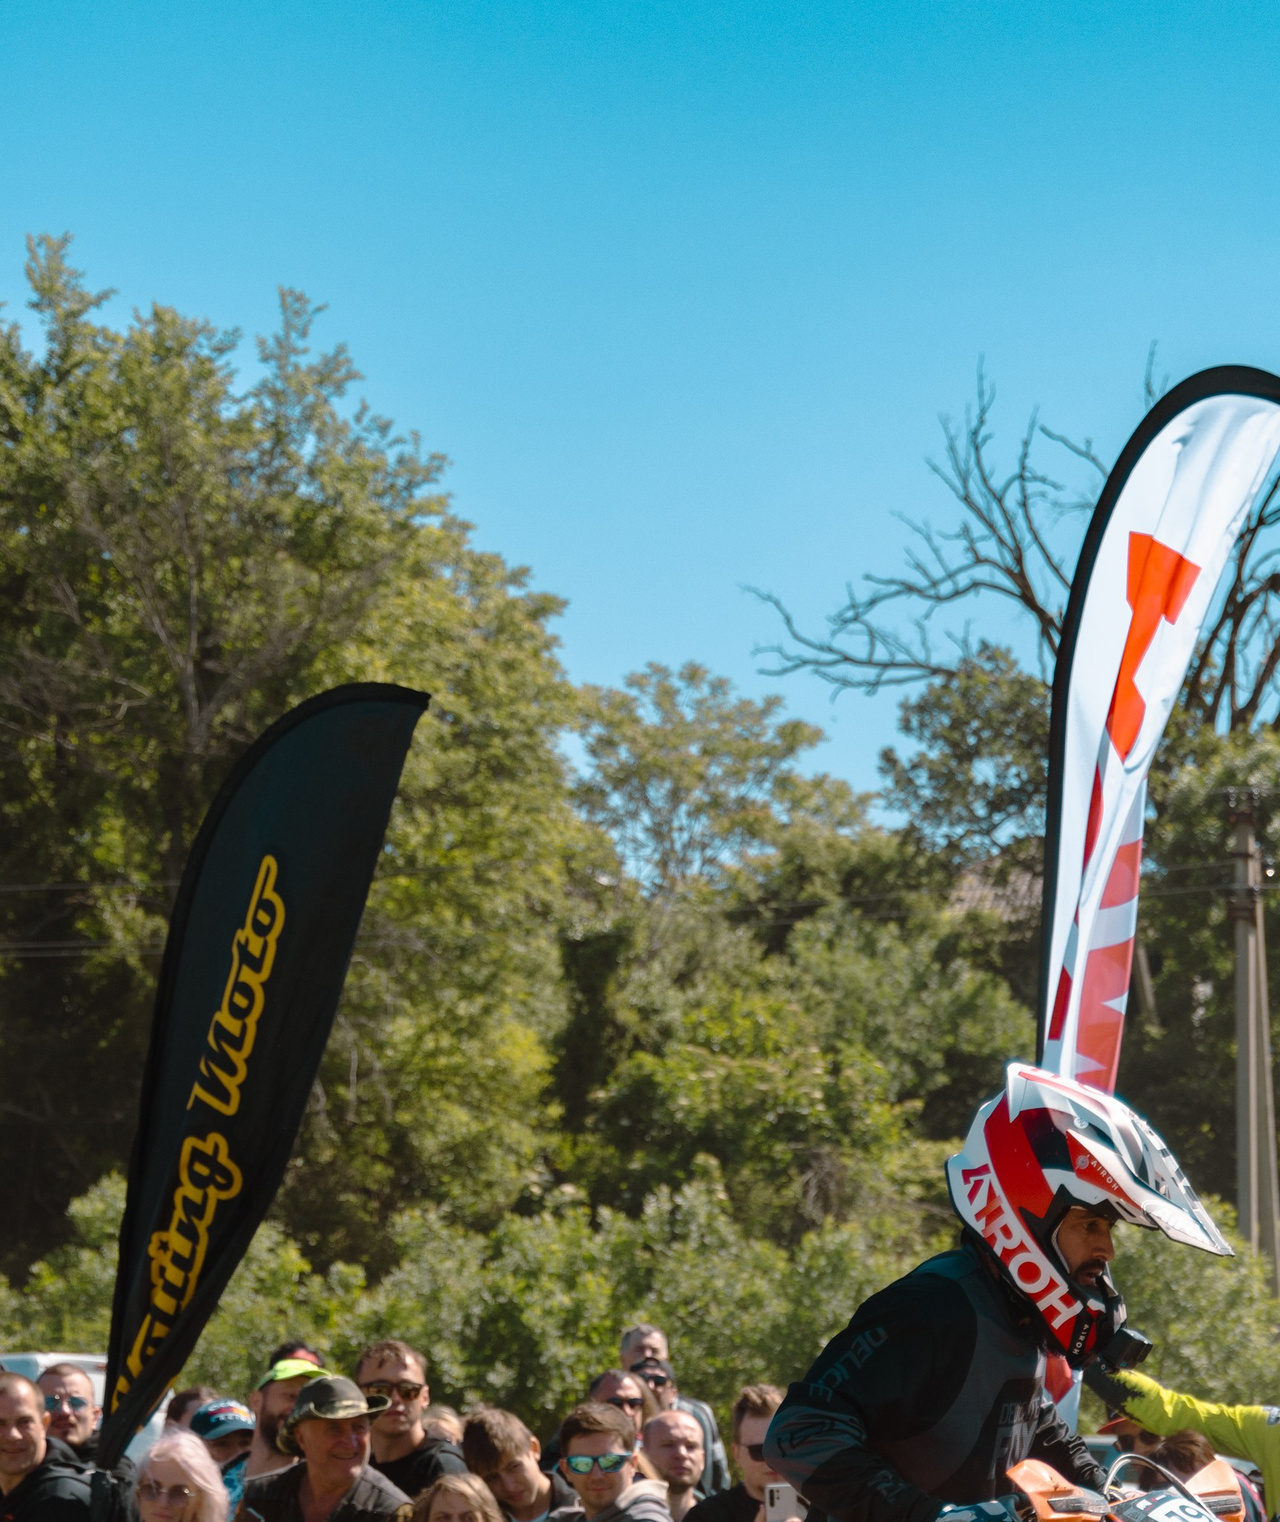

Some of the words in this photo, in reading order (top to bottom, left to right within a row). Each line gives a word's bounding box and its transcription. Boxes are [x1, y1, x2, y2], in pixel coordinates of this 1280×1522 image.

[186, 854, 285, 1116] Moto
[1090, 1159, 1119, 1192] AIROH
[960, 1162, 1084, 1330] AIROH
[1072, 1323, 1090, 1355] AIROH
